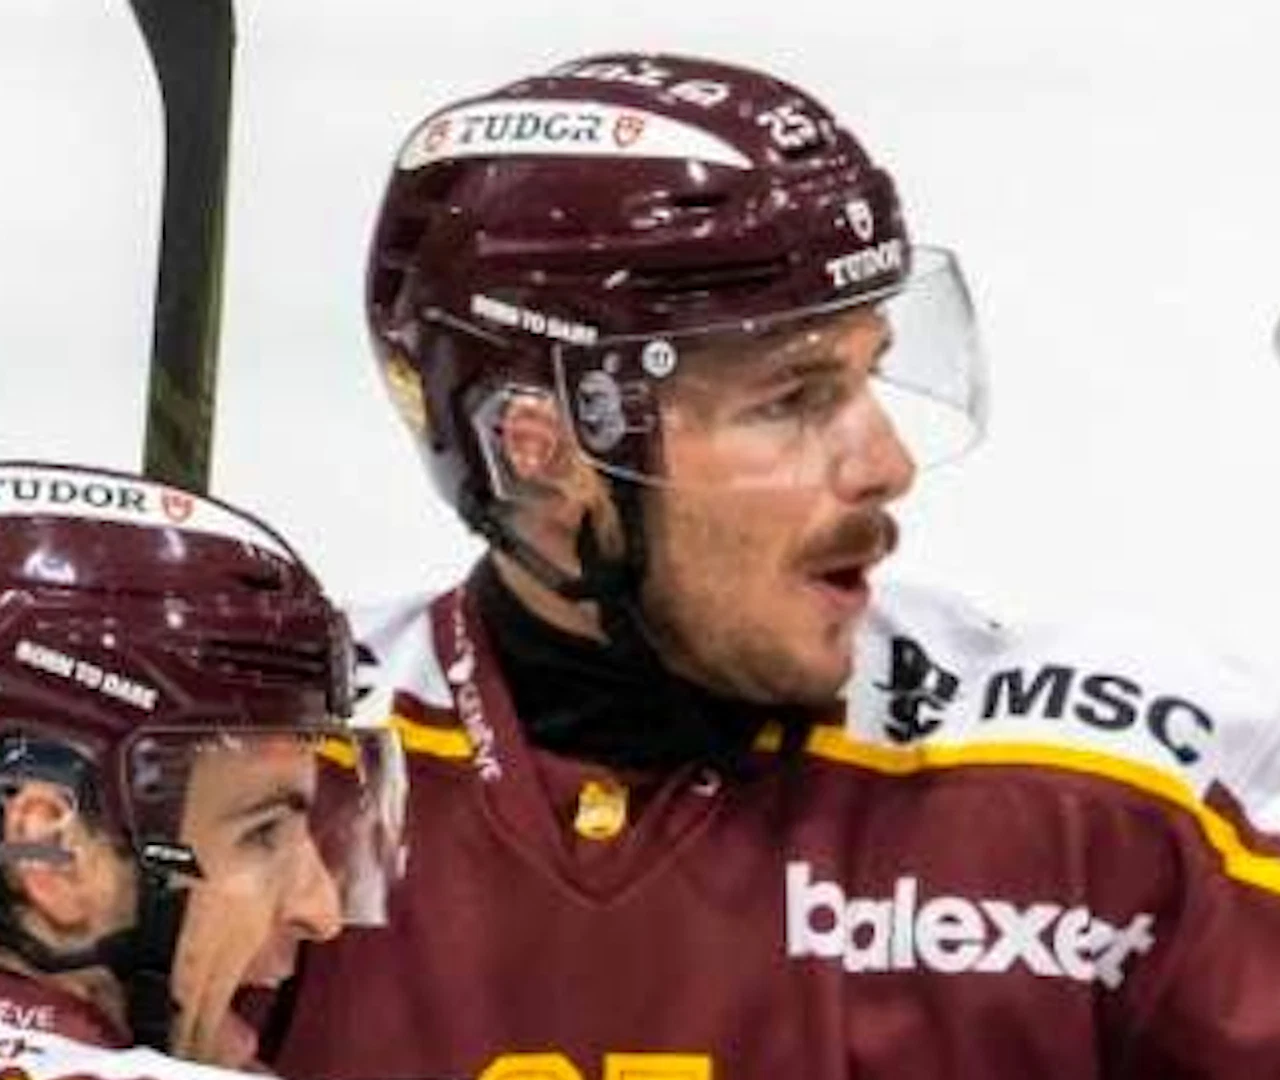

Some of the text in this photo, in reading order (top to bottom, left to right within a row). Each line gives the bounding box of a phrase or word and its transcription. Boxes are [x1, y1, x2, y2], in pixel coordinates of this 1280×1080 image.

[457, 110, 601, 145] TUDOR
[756, 103, 818, 150] 25
[75, 661, 104, 690] TO
[981, 663, 1214, 766] MSC
